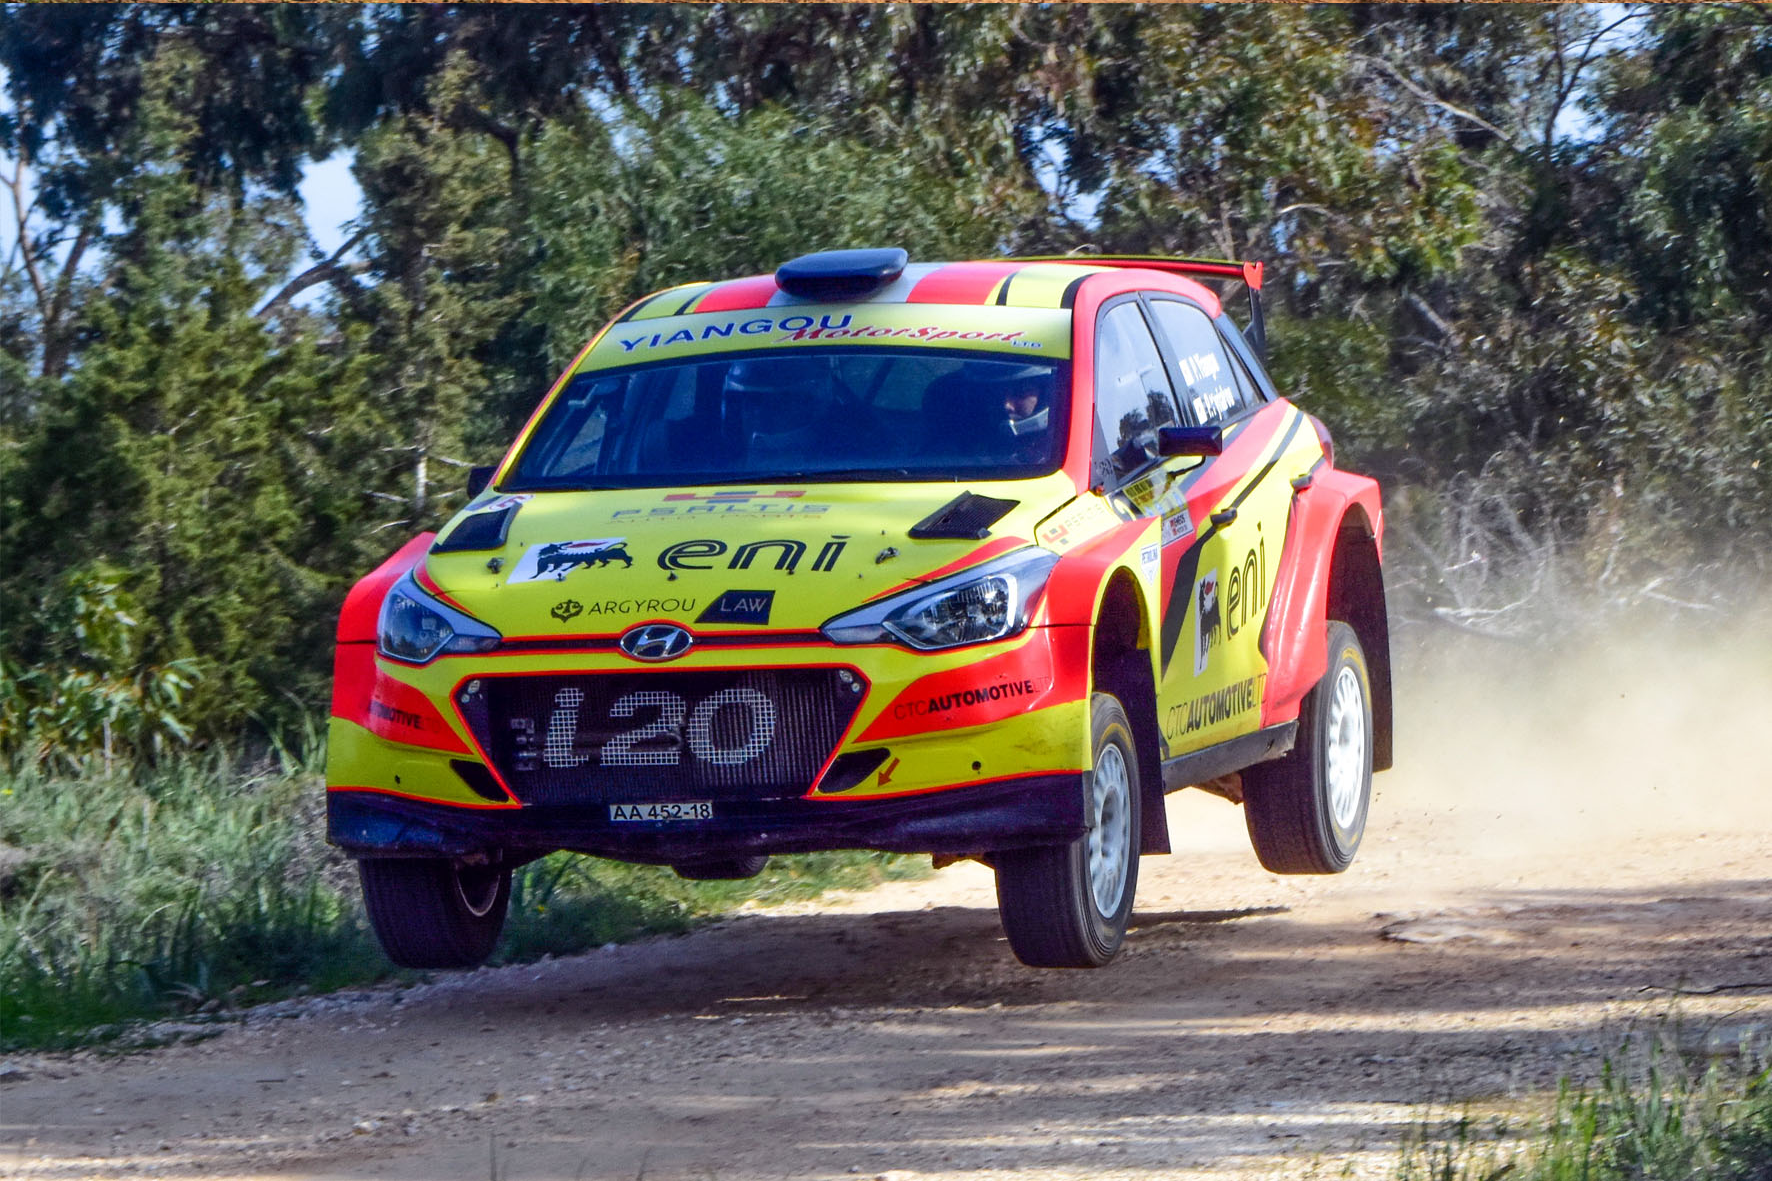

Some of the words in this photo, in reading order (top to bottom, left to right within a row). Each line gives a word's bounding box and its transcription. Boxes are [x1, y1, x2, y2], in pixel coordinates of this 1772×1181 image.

[620, 314, 853, 352] YIANGOU
[657, 535, 851, 571] eni
[1226, 521, 1265, 640] eni
[588, 599, 696, 616] ARGYROU
[720, 598, 768, 613] LAW
[543, 688, 777, 767] i20
[613, 804, 643, 820] AA
[647, 803, 711, 820] 452-18
